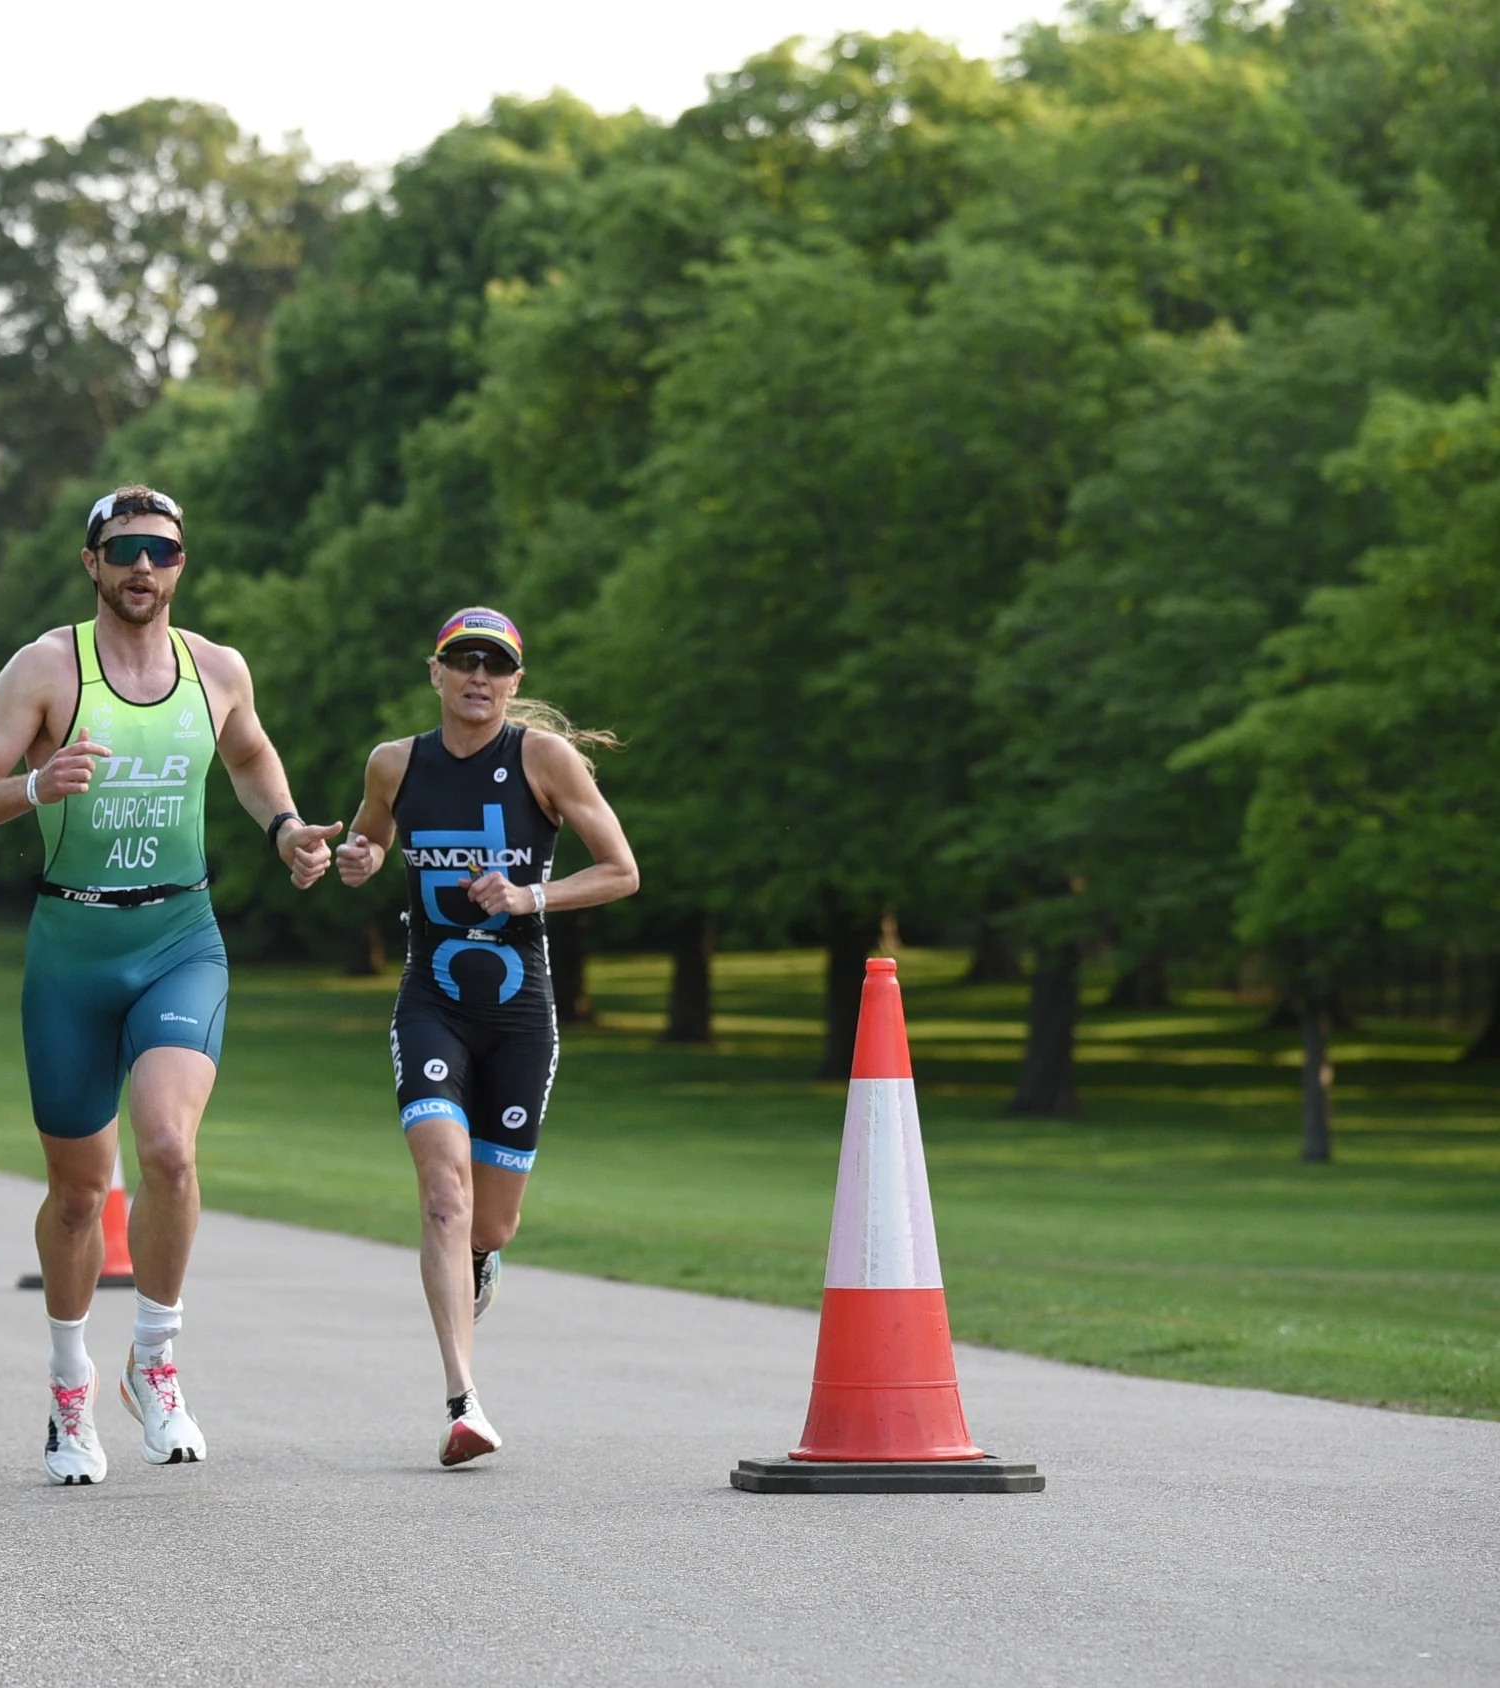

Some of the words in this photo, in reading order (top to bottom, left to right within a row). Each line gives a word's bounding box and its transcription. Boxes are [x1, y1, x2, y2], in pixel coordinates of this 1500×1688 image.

[100, 754, 190, 780] TLR
[92, 795, 184, 829] CHURCHETT
[105, 836, 159, 869] AUS
[60, 887, 102, 903] T100
